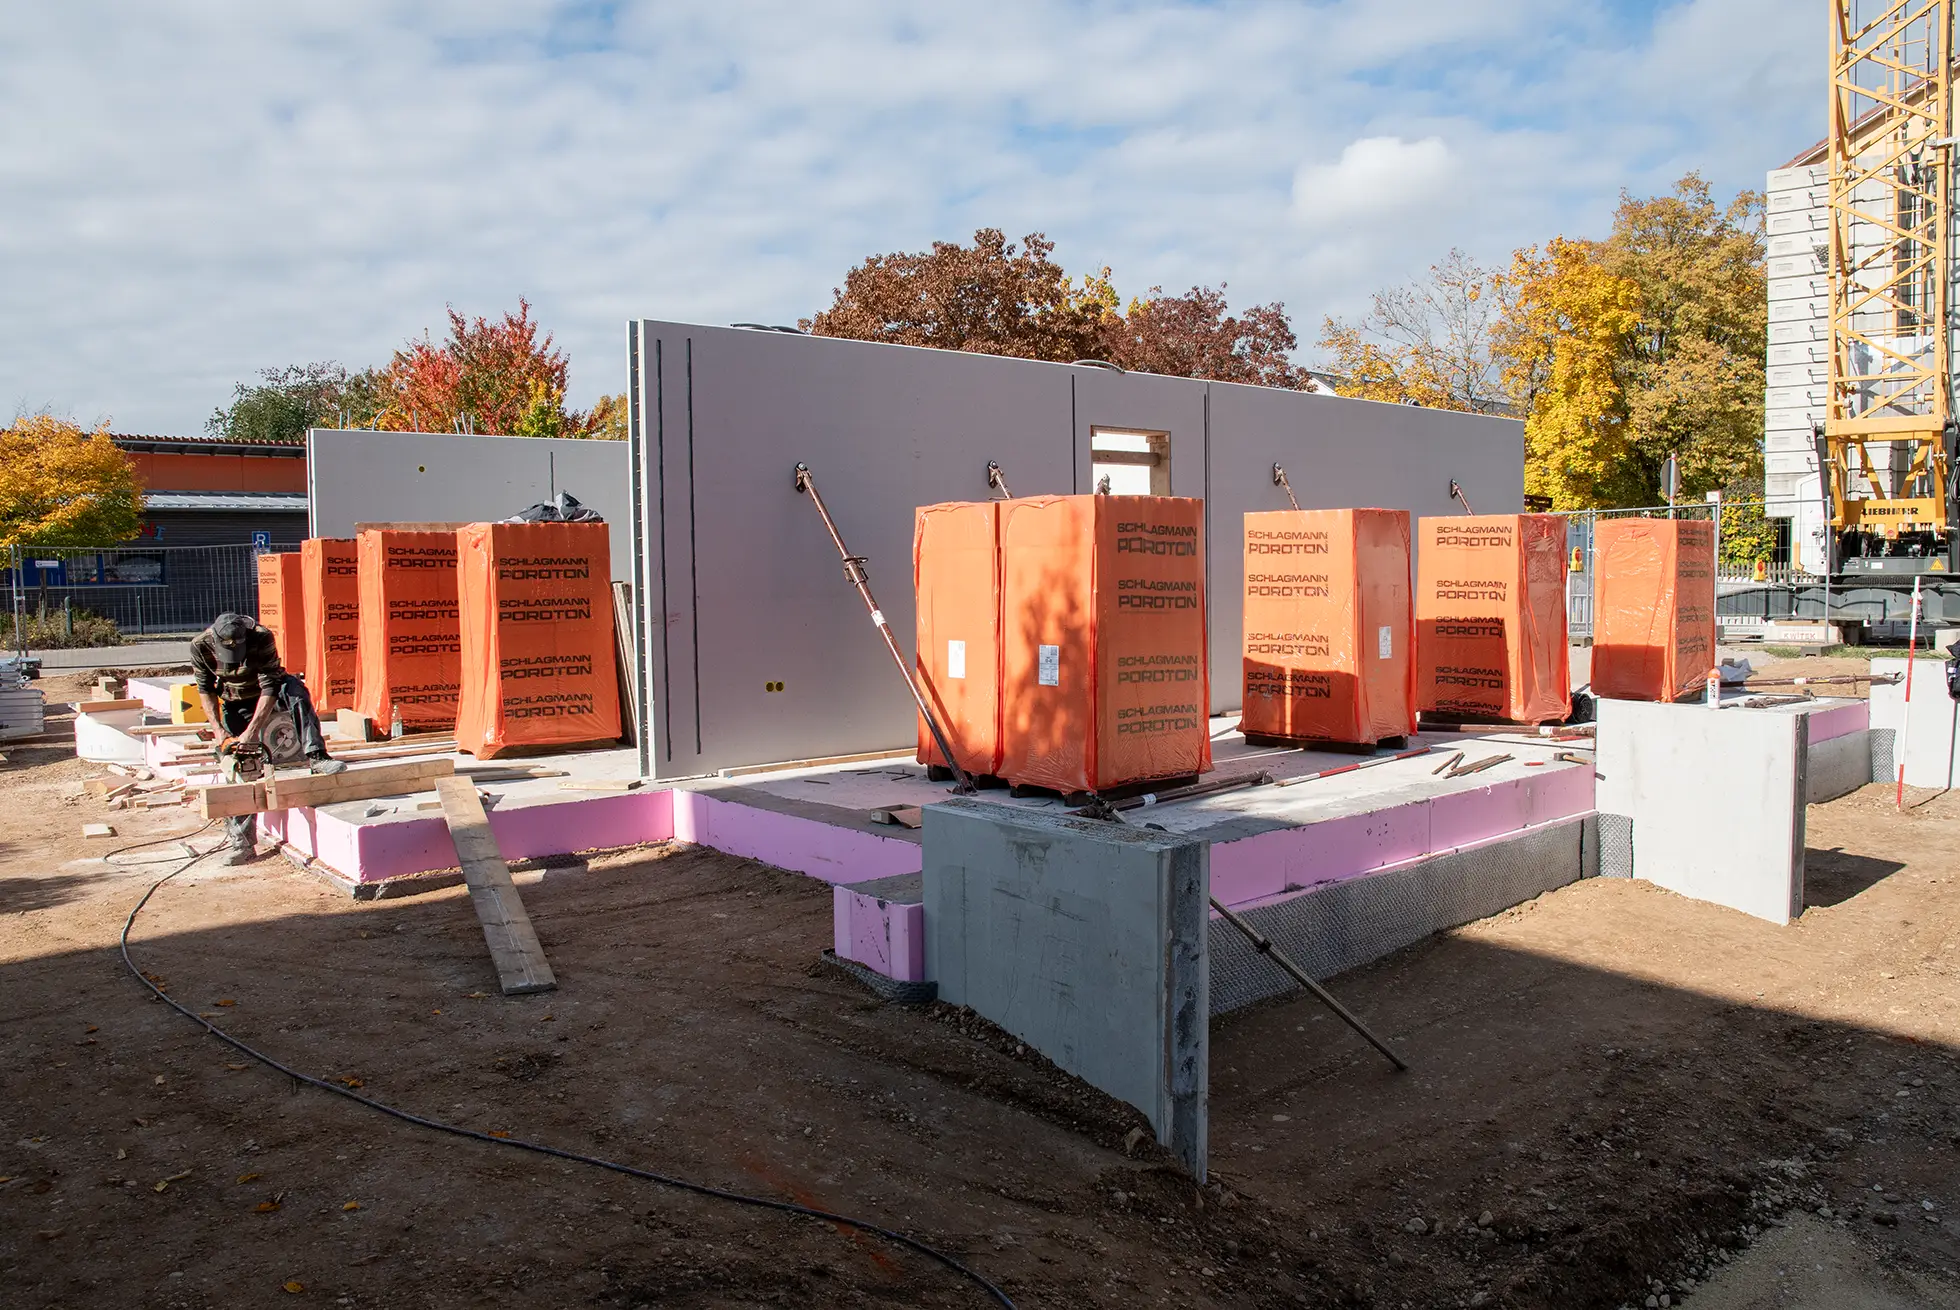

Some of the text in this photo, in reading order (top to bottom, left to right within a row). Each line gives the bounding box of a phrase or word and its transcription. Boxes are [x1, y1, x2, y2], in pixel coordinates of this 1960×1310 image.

[1117, 523, 1197, 537] SCHLAGMANN
[1248, 530, 1328, 540] SCHLAGMANN
[1436, 526, 1512, 534] SCHLAGMANN
[1117, 537, 1197, 556] POROTON
[1436, 536, 1512, 547] POROTON
[1248, 542, 1328, 554] POROTON
[388, 558, 458, 568] POROTO
[500, 558, 588, 566] SCHLAGMANN
[500, 568, 589, 580] POROTON
[1248, 574, 1328, 583] SCHLAGMANN
[1118, 579, 1196, 591] SCHLAGMANN
[1248, 585, 1328, 597] POROTON
[500, 598, 590, 608] SCHLAGMANN
[1118, 594, 1197, 609] POROTON
[390, 609, 459, 620] POROTO
[499, 608, 591, 621] POROTON
[390, 634, 460, 643] SCHLAGMAN
[1247, 633, 1329, 643] SCHLAGMANN
[390, 643, 460, 655] POROTO
[1247, 643, 1329, 656] POROTON
[500, 655, 592, 667] SCHLAGMANN
[1118, 655, 1198, 667] SCHLAGMANN
[501, 665, 592, 680] POROTON
[1117, 668, 1198, 684] POROTON
[1247, 671, 1330, 684] SCHLAGMANN
[1247, 683, 1331, 698] POROTON
[390, 693, 459, 704] POROTO
[503, 693, 593, 706] SCHLAGMANN
[1117, 704, 1197, 719] SCHLAGMANN
[1117, 717, 1198, 735] POROTON
